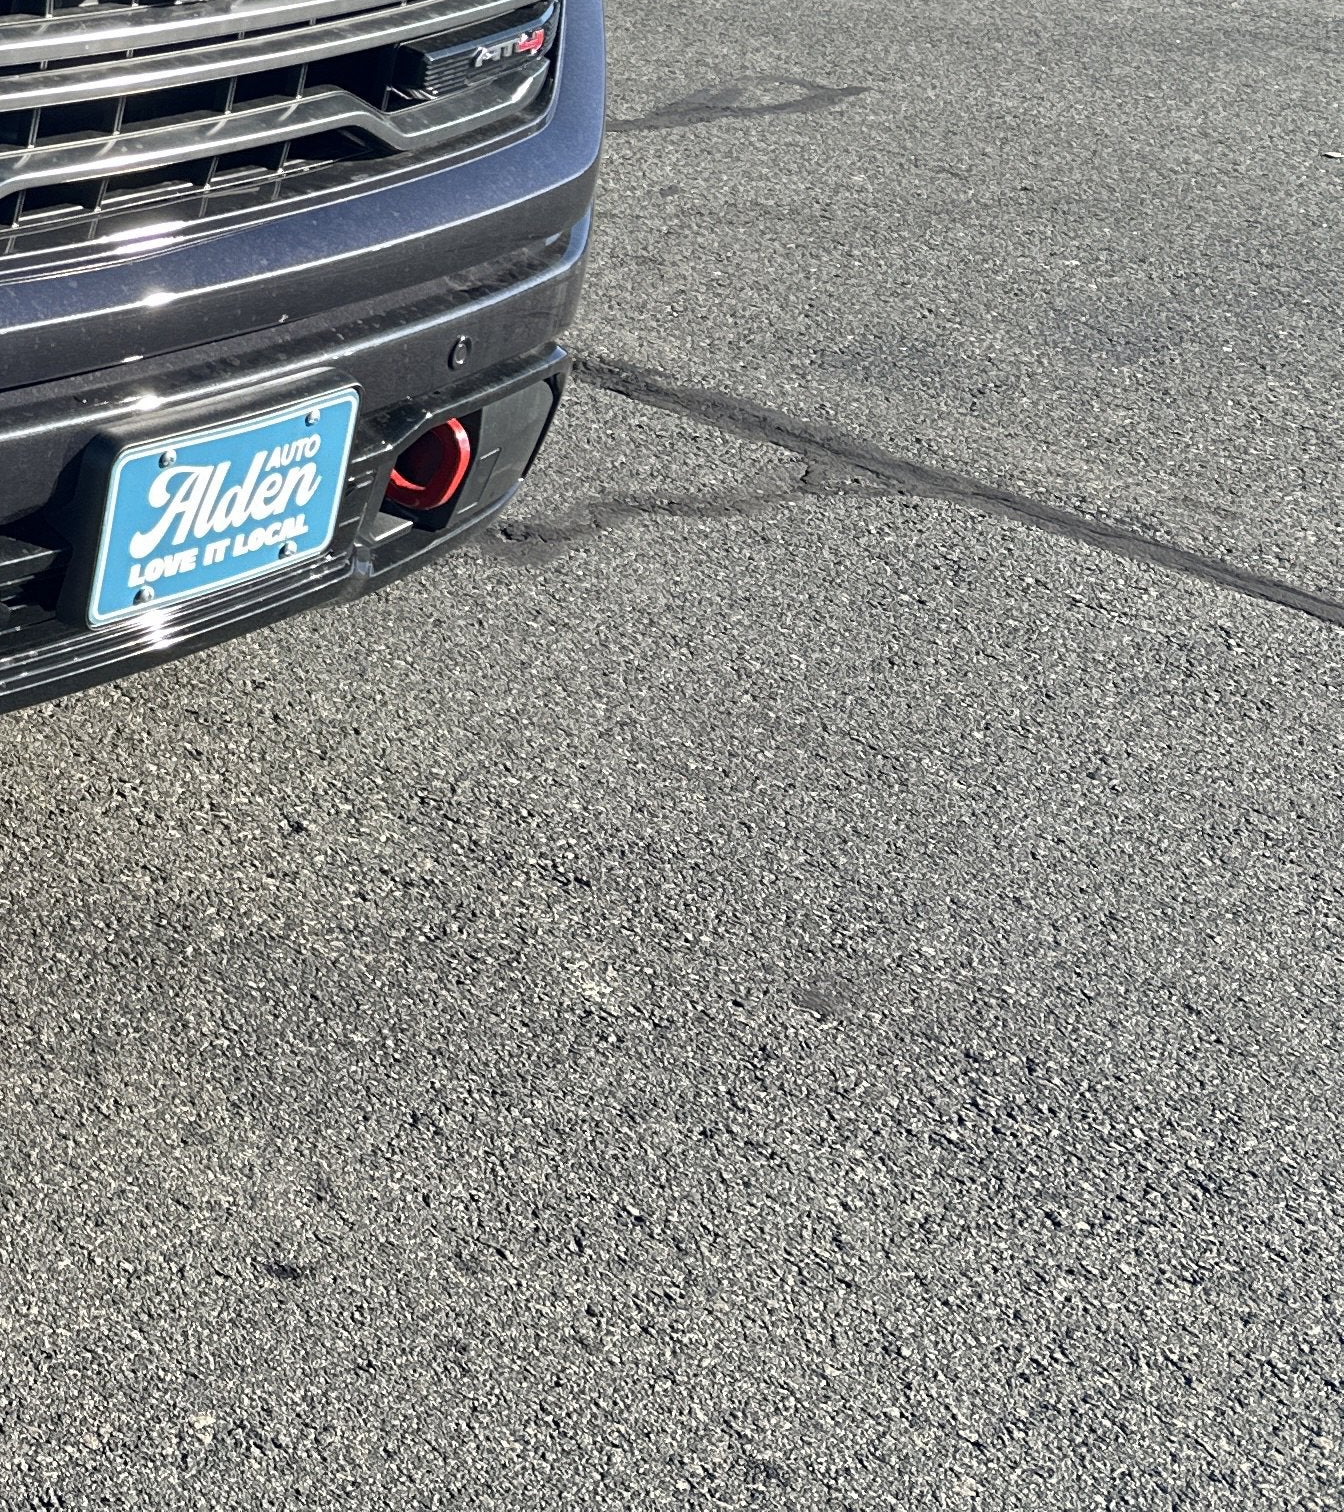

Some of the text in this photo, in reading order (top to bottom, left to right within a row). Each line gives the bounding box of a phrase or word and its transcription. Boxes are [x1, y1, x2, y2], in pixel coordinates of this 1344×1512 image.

[470, 29, 545, 68] AT4
[265, 433, 322, 472] AUTO
[128, 450, 323, 560] Alden
[128, 513, 309, 588] LOVE IT LOCAL
